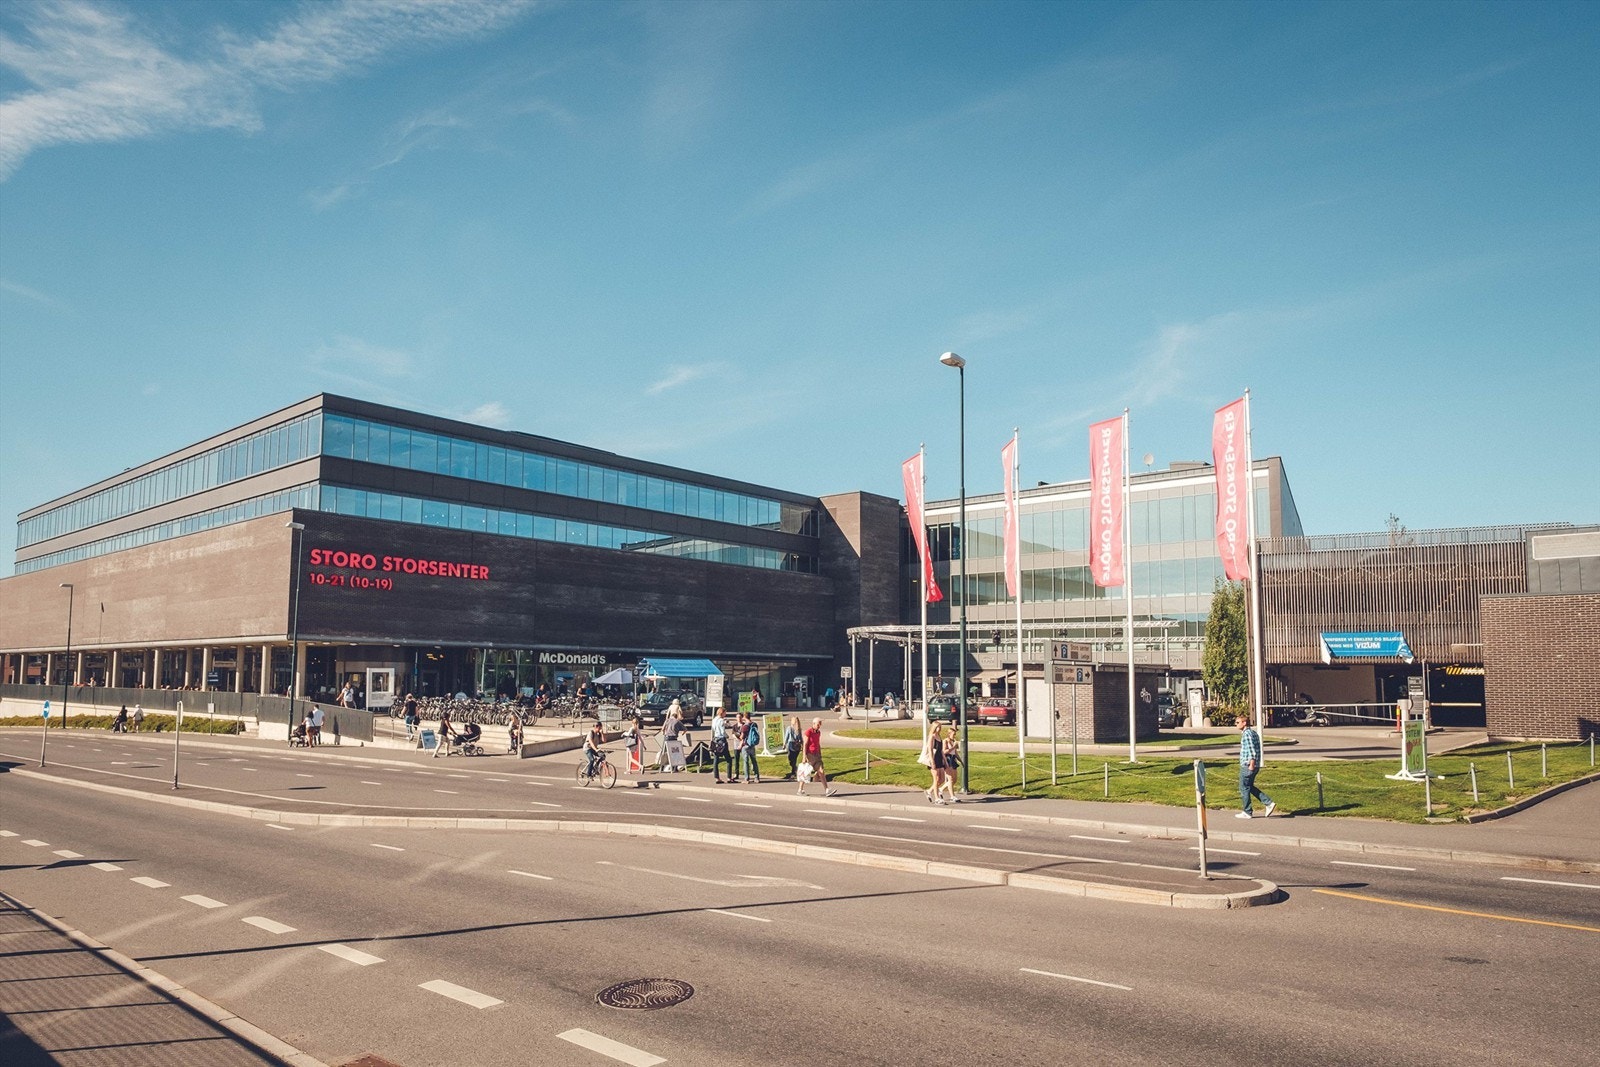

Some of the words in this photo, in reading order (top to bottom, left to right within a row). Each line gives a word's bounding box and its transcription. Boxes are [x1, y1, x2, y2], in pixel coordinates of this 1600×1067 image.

[310, 549, 377, 570] STORO
[382, 555, 490, 580] STORSENTER
[310, 573, 345, 586] 10-21
[350, 575, 393, 590] (10-19)
[1355, 641, 1381, 649] VIZUM
[539, 652, 606, 665] McDonald's
